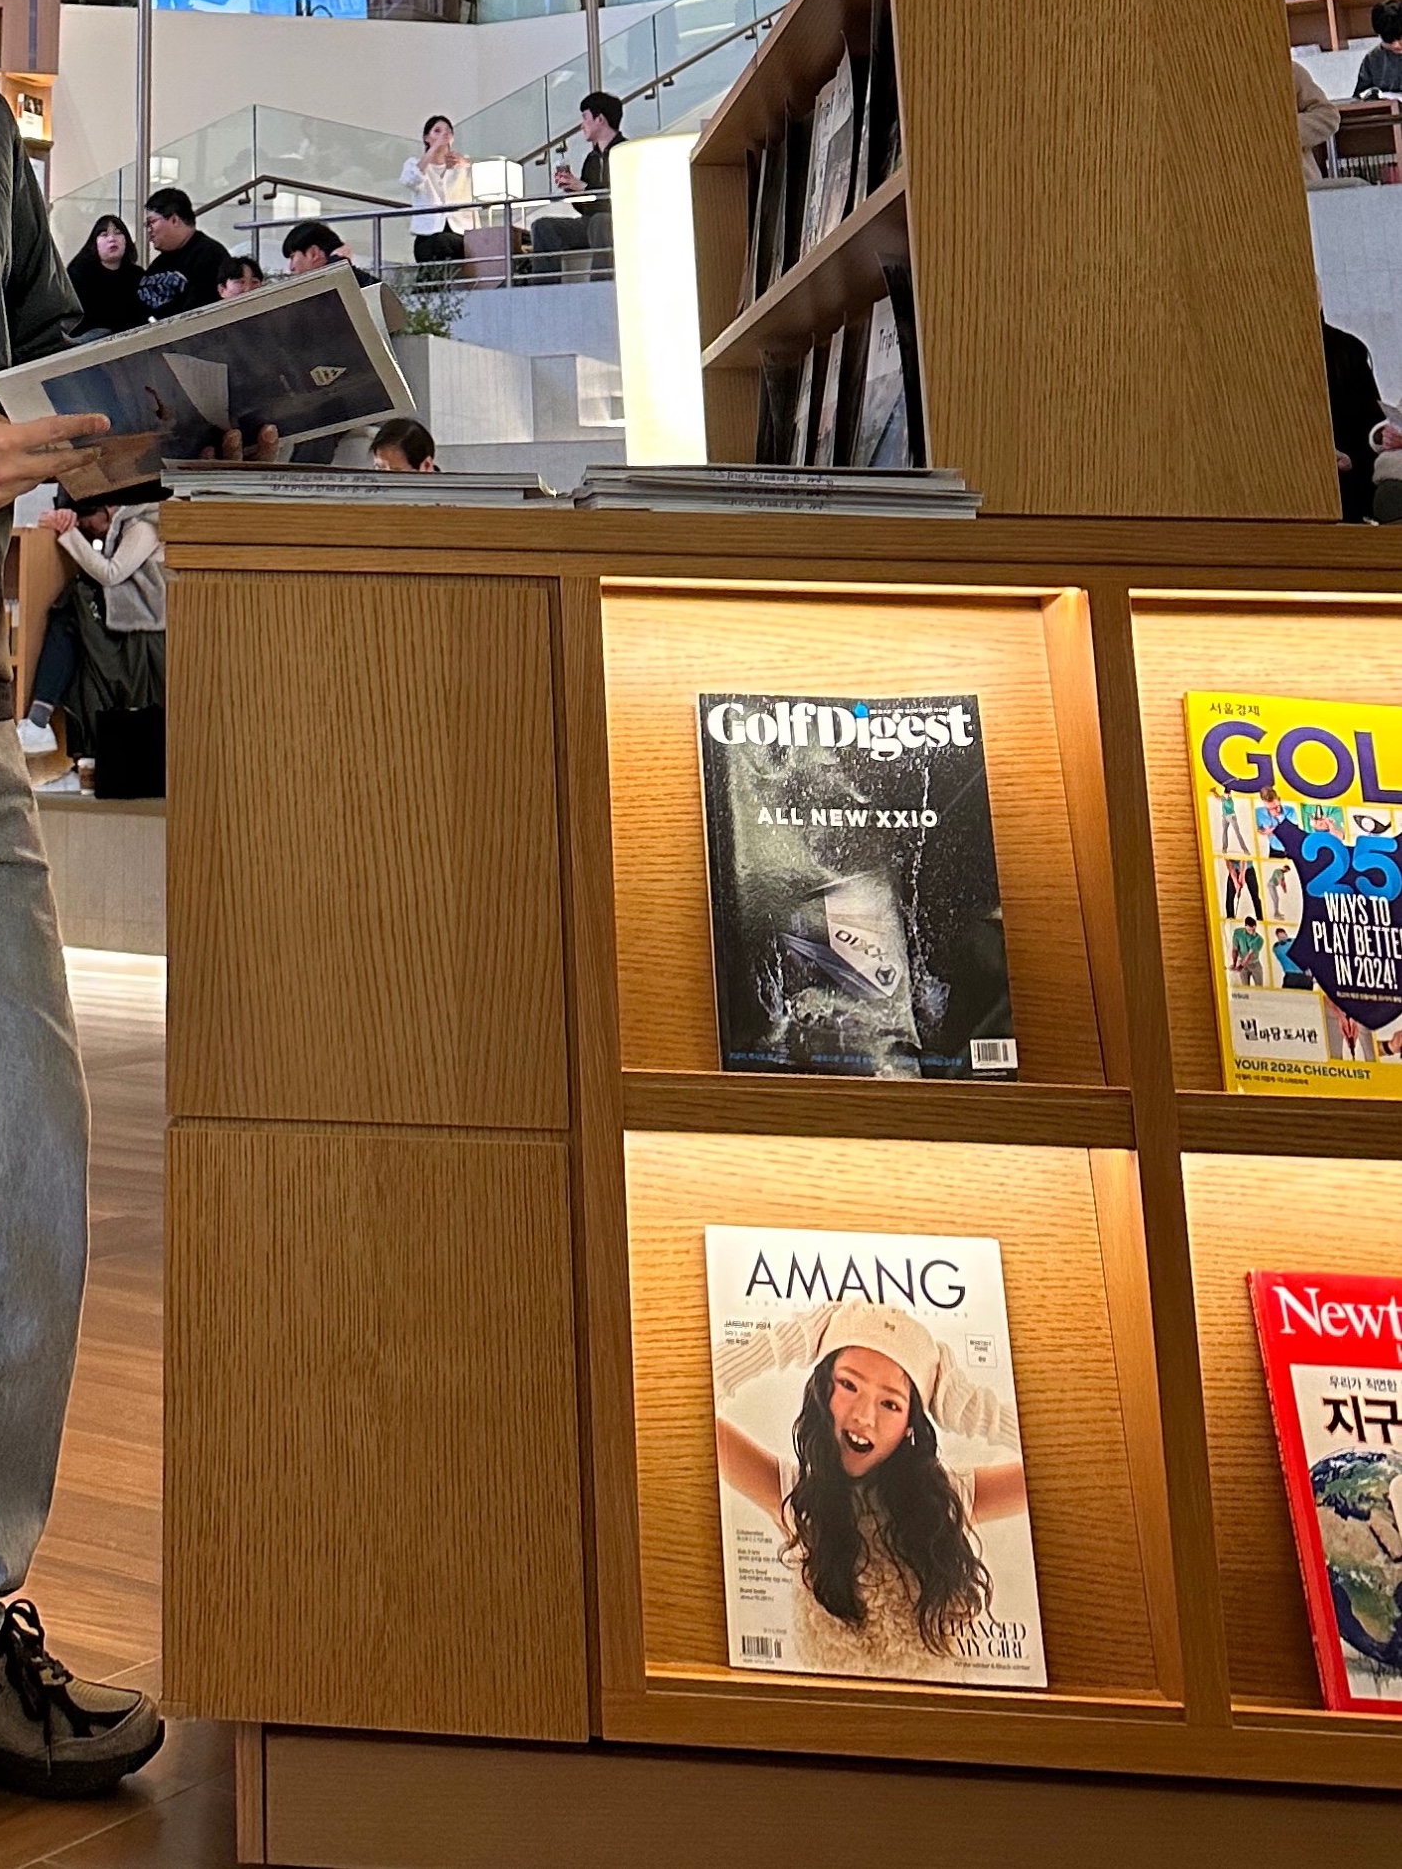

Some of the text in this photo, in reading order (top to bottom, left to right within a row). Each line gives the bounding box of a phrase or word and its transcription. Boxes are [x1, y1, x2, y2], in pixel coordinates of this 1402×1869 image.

[1209, 702, 1260, 717] 서울경제
[757, 806, 938, 829] ALL NEW XXIO
[1301, 832, 1402, 902] 25
[1324, 891, 1392, 927] WAYS TO
[1311, 921, 1402, 960] PLAY BETTE
[1334, 955, 1399, 990] IN 2024!
[1235, 1059, 1269, 1072] YOUR
[1271, 1062, 1302, 1075] 2024
[1303, 1065, 1372, 1080] CHECKLIST
[745, 1248, 967, 1310] AMANG
[1329, 1375, 1362, 1391] 우리가
[1322, 1395, 1402, 1444] 지구
